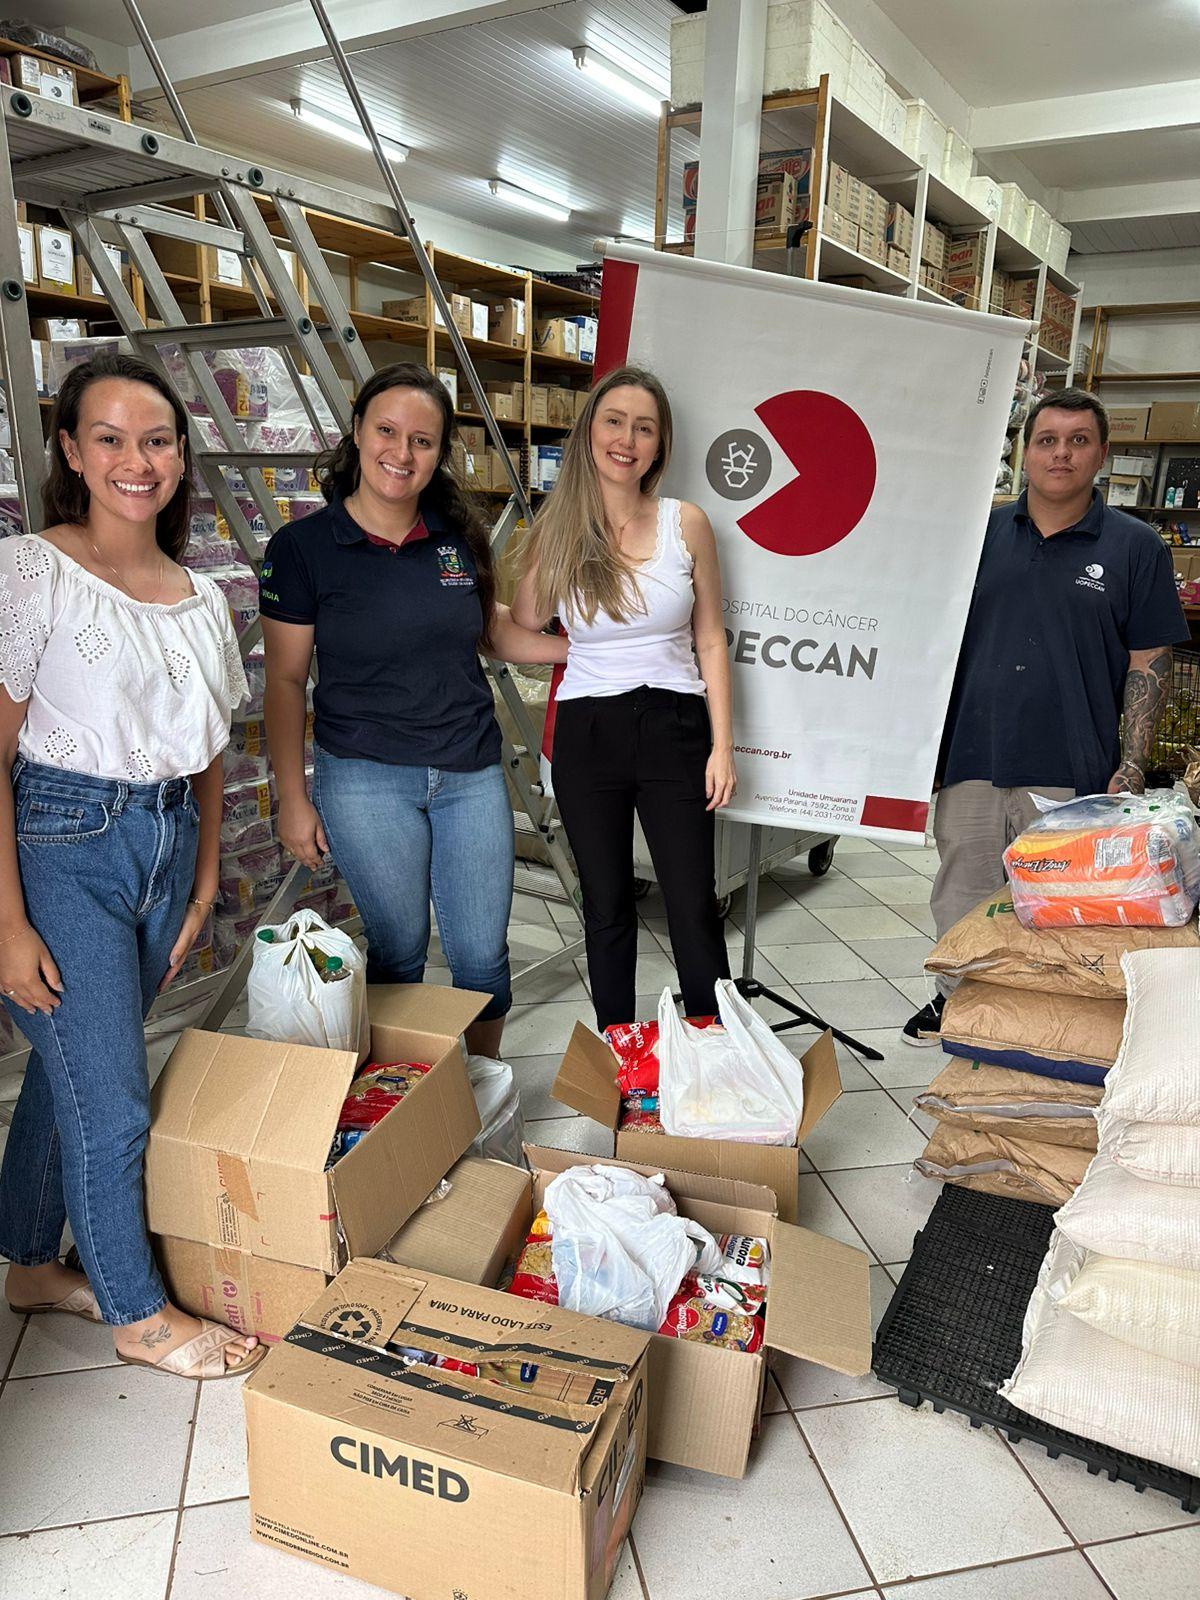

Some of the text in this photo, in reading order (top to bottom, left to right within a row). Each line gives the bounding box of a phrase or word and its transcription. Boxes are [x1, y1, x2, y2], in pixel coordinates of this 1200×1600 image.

[721, 598, 879, 632] OSPITAL DO CÂNCER
[725, 627, 879, 680] PECCAN
[733, 745, 792, 759] eccan.org.br
[755, 793, 782, 803] Avenida
[788, 788, 858, 805] Unidade Umuarama
[800, 808, 813, 817] (44)
[985, 902, 1014, 918] al
[736, 1236, 754, 1266] Aurora
[430, 1299, 459, 1314] CIMA
[224, 1302, 241, 1331] rati
[461, 1306, 491, 1324] PARA
[491, 1316, 523, 1330] LADO
[288, 1331, 313, 1341] CIMED
[322, 1343, 346, 1353] CIMED
[356, 1355, 380, 1365] CIMED
[598, 1378, 643, 1508] CIED
[330, 1435, 470, 1504] CIMED
[255, 1518, 349, 1559] WWW.CIMEDONLINE.COM.BR
